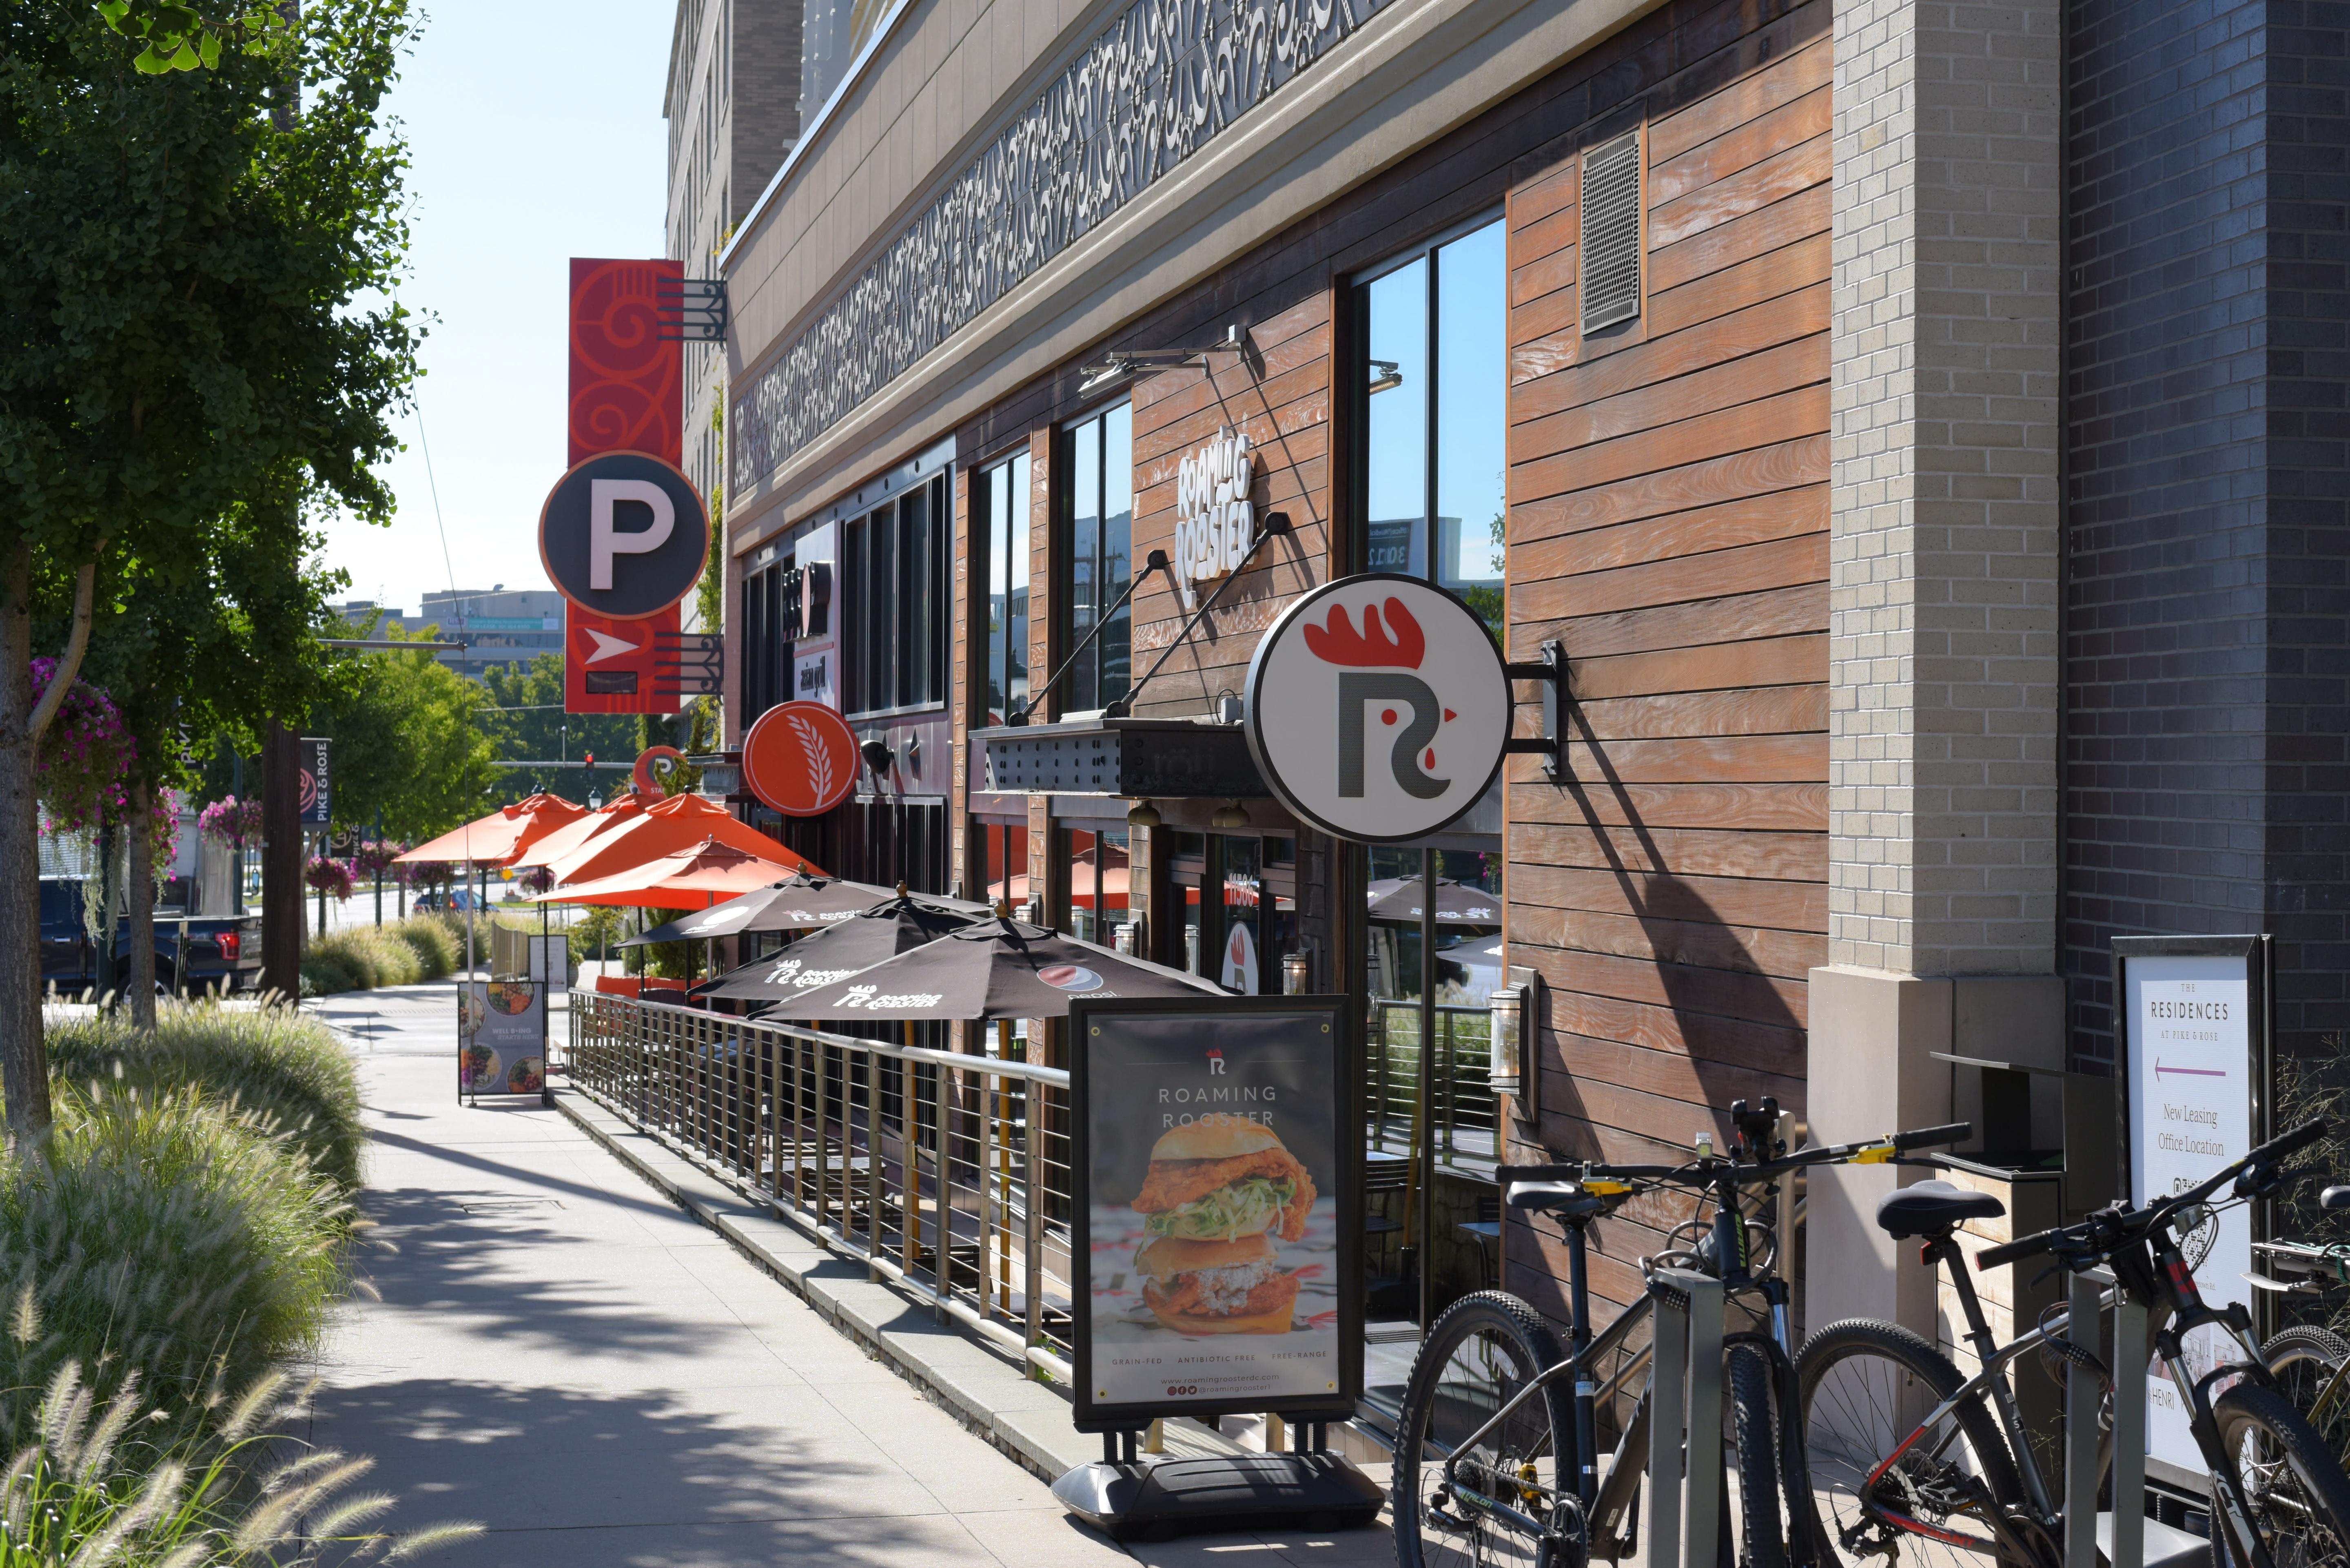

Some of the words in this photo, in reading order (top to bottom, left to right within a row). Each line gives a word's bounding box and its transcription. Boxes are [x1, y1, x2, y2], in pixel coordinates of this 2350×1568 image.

[590, 478, 675, 590] P
[1175, 478, 1255, 609] ROOSTER
[317, 742, 327, 777] ROSE
[317, 778, 328, 789] &
[317, 792, 327, 822] PIKE
[352, 835, 361, 856] PIKE
[1228, 873, 1254, 907] 11586
[2181, 983, 2195, 992] THE
[2151, 1001, 2228, 1020] RESIDENCES
[2160, 1030, 2169, 1039] AT
[2173, 1030, 2190, 1040] PIKE
[2193, 1031, 2197, 1040] &
[2199, 1032, 2218, 1041] ROSE
[1159, 1086, 1276, 1103] ROAMING
[1163, 1111, 1273, 1128] ROOSTER
[2164, 1103, 2183, 1121] New
[2183, 1102, 2218, 1129] Leasing
[2158, 1132, 2183, 1152] Office
[2185, 1136, 2225, 1156] Location
[1177, 1355, 1231, 1364] ANTIBIOTIC
[1271, 1351, 1327, 1360] FREE-RANGE
[1160, 1374, 1279, 1385] www.roamingroosterdc.com
[1198, 1384, 1270, 1394] @roamingrooster1
[2152, 1386, 2175, 1410] HENRI
[1397, 1406, 1414, 1492] KENDA
[1465, 1490, 1493, 1509] TALON
